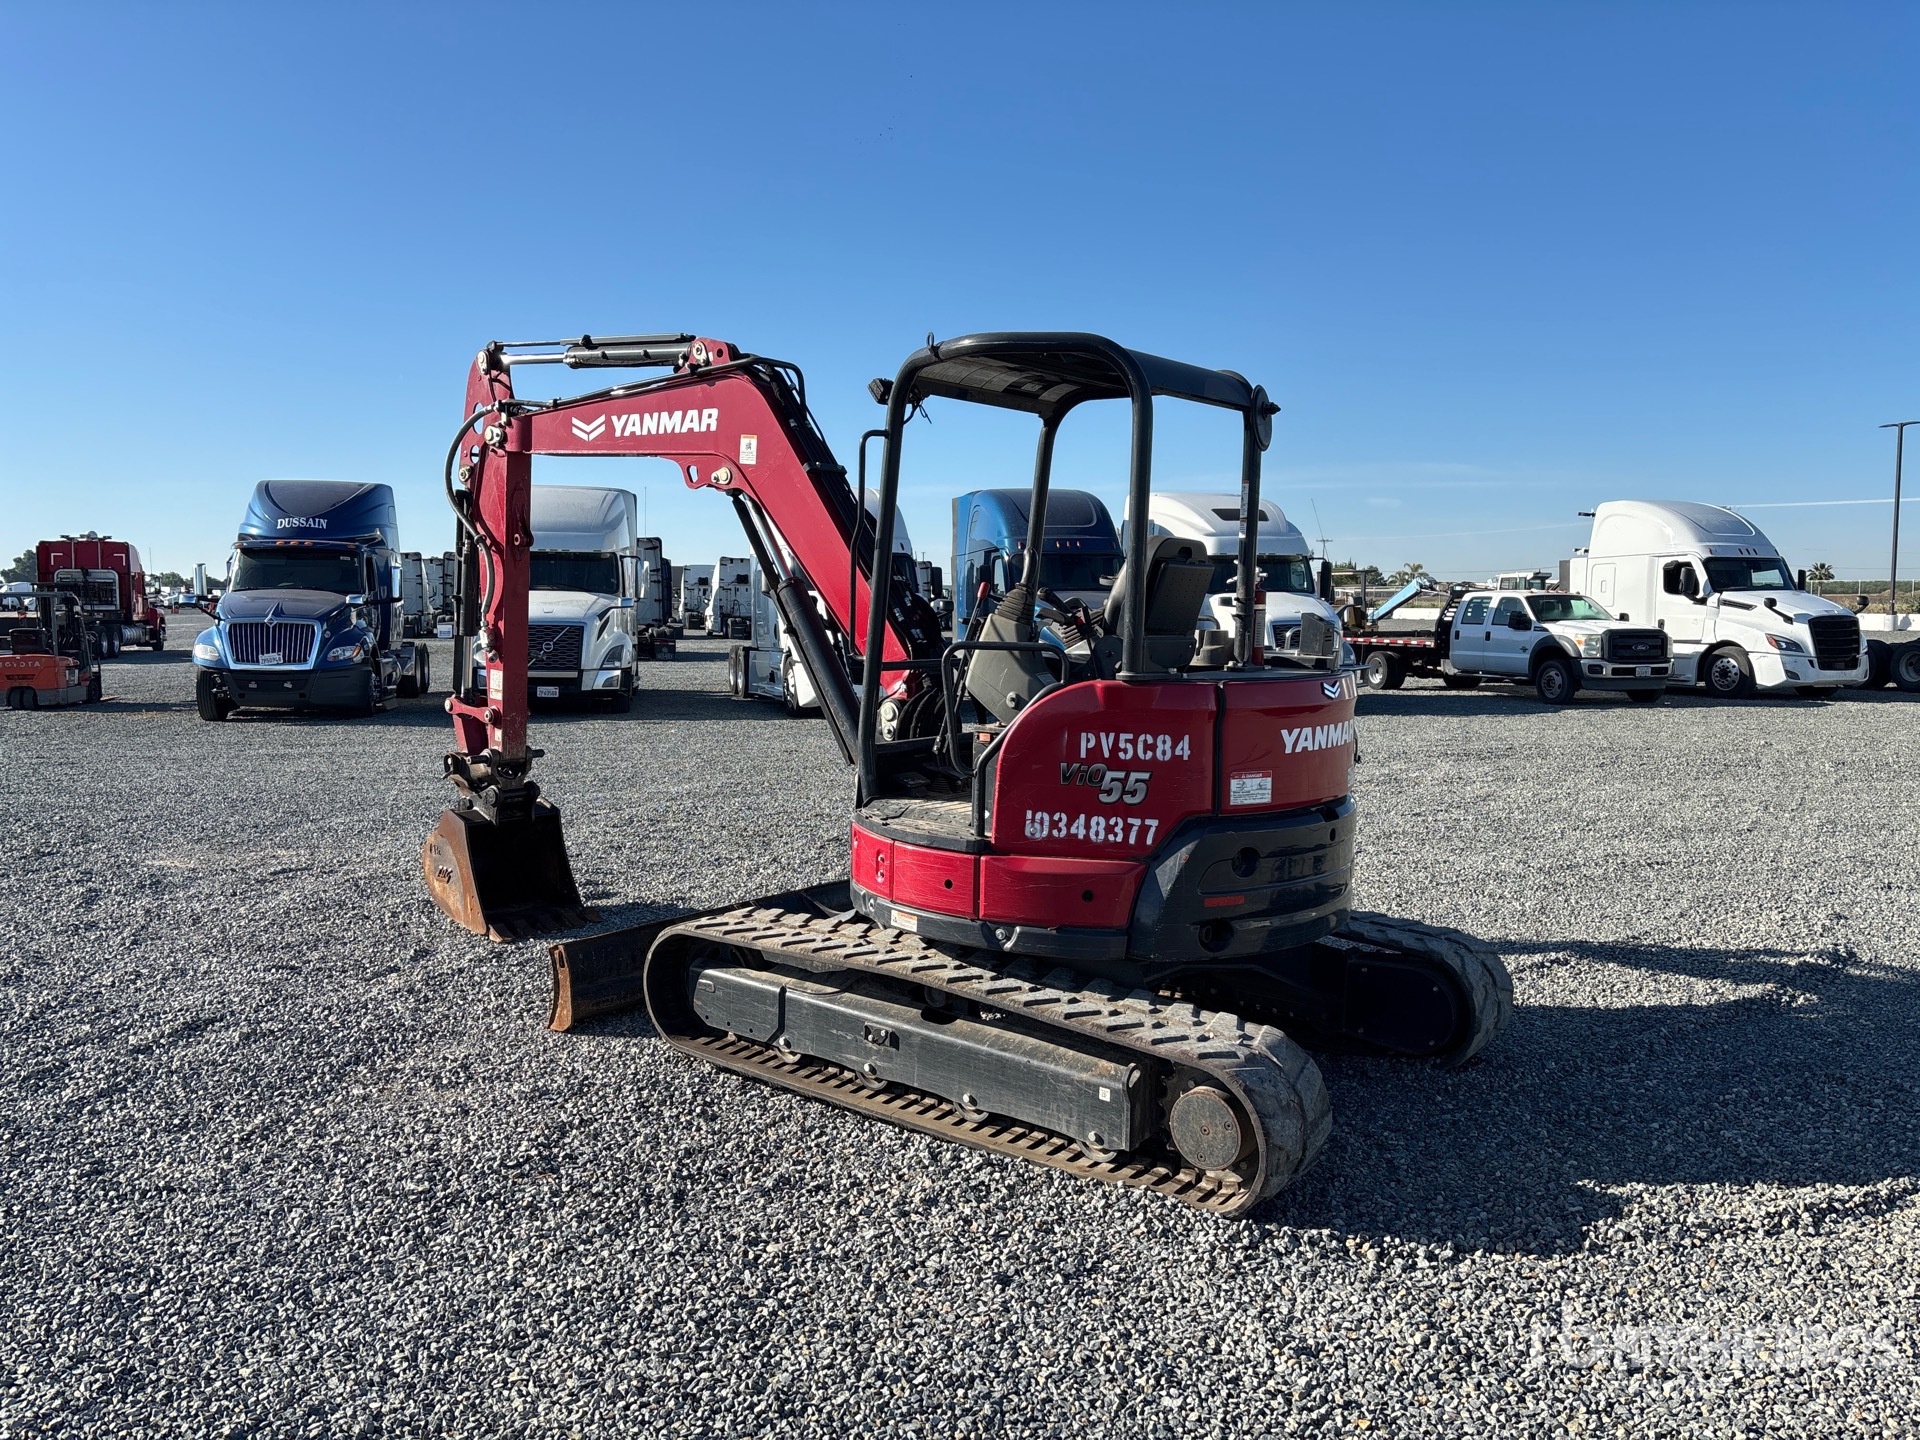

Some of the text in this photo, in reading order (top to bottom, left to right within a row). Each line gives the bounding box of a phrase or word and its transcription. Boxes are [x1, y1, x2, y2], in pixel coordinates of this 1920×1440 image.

[611, 408, 719, 438] YANMAR
[277, 517, 328, 529] DUSSAIN
[1080, 732, 1191, 762] PV5C84
[1281, 719, 1354, 754] YANMAR
